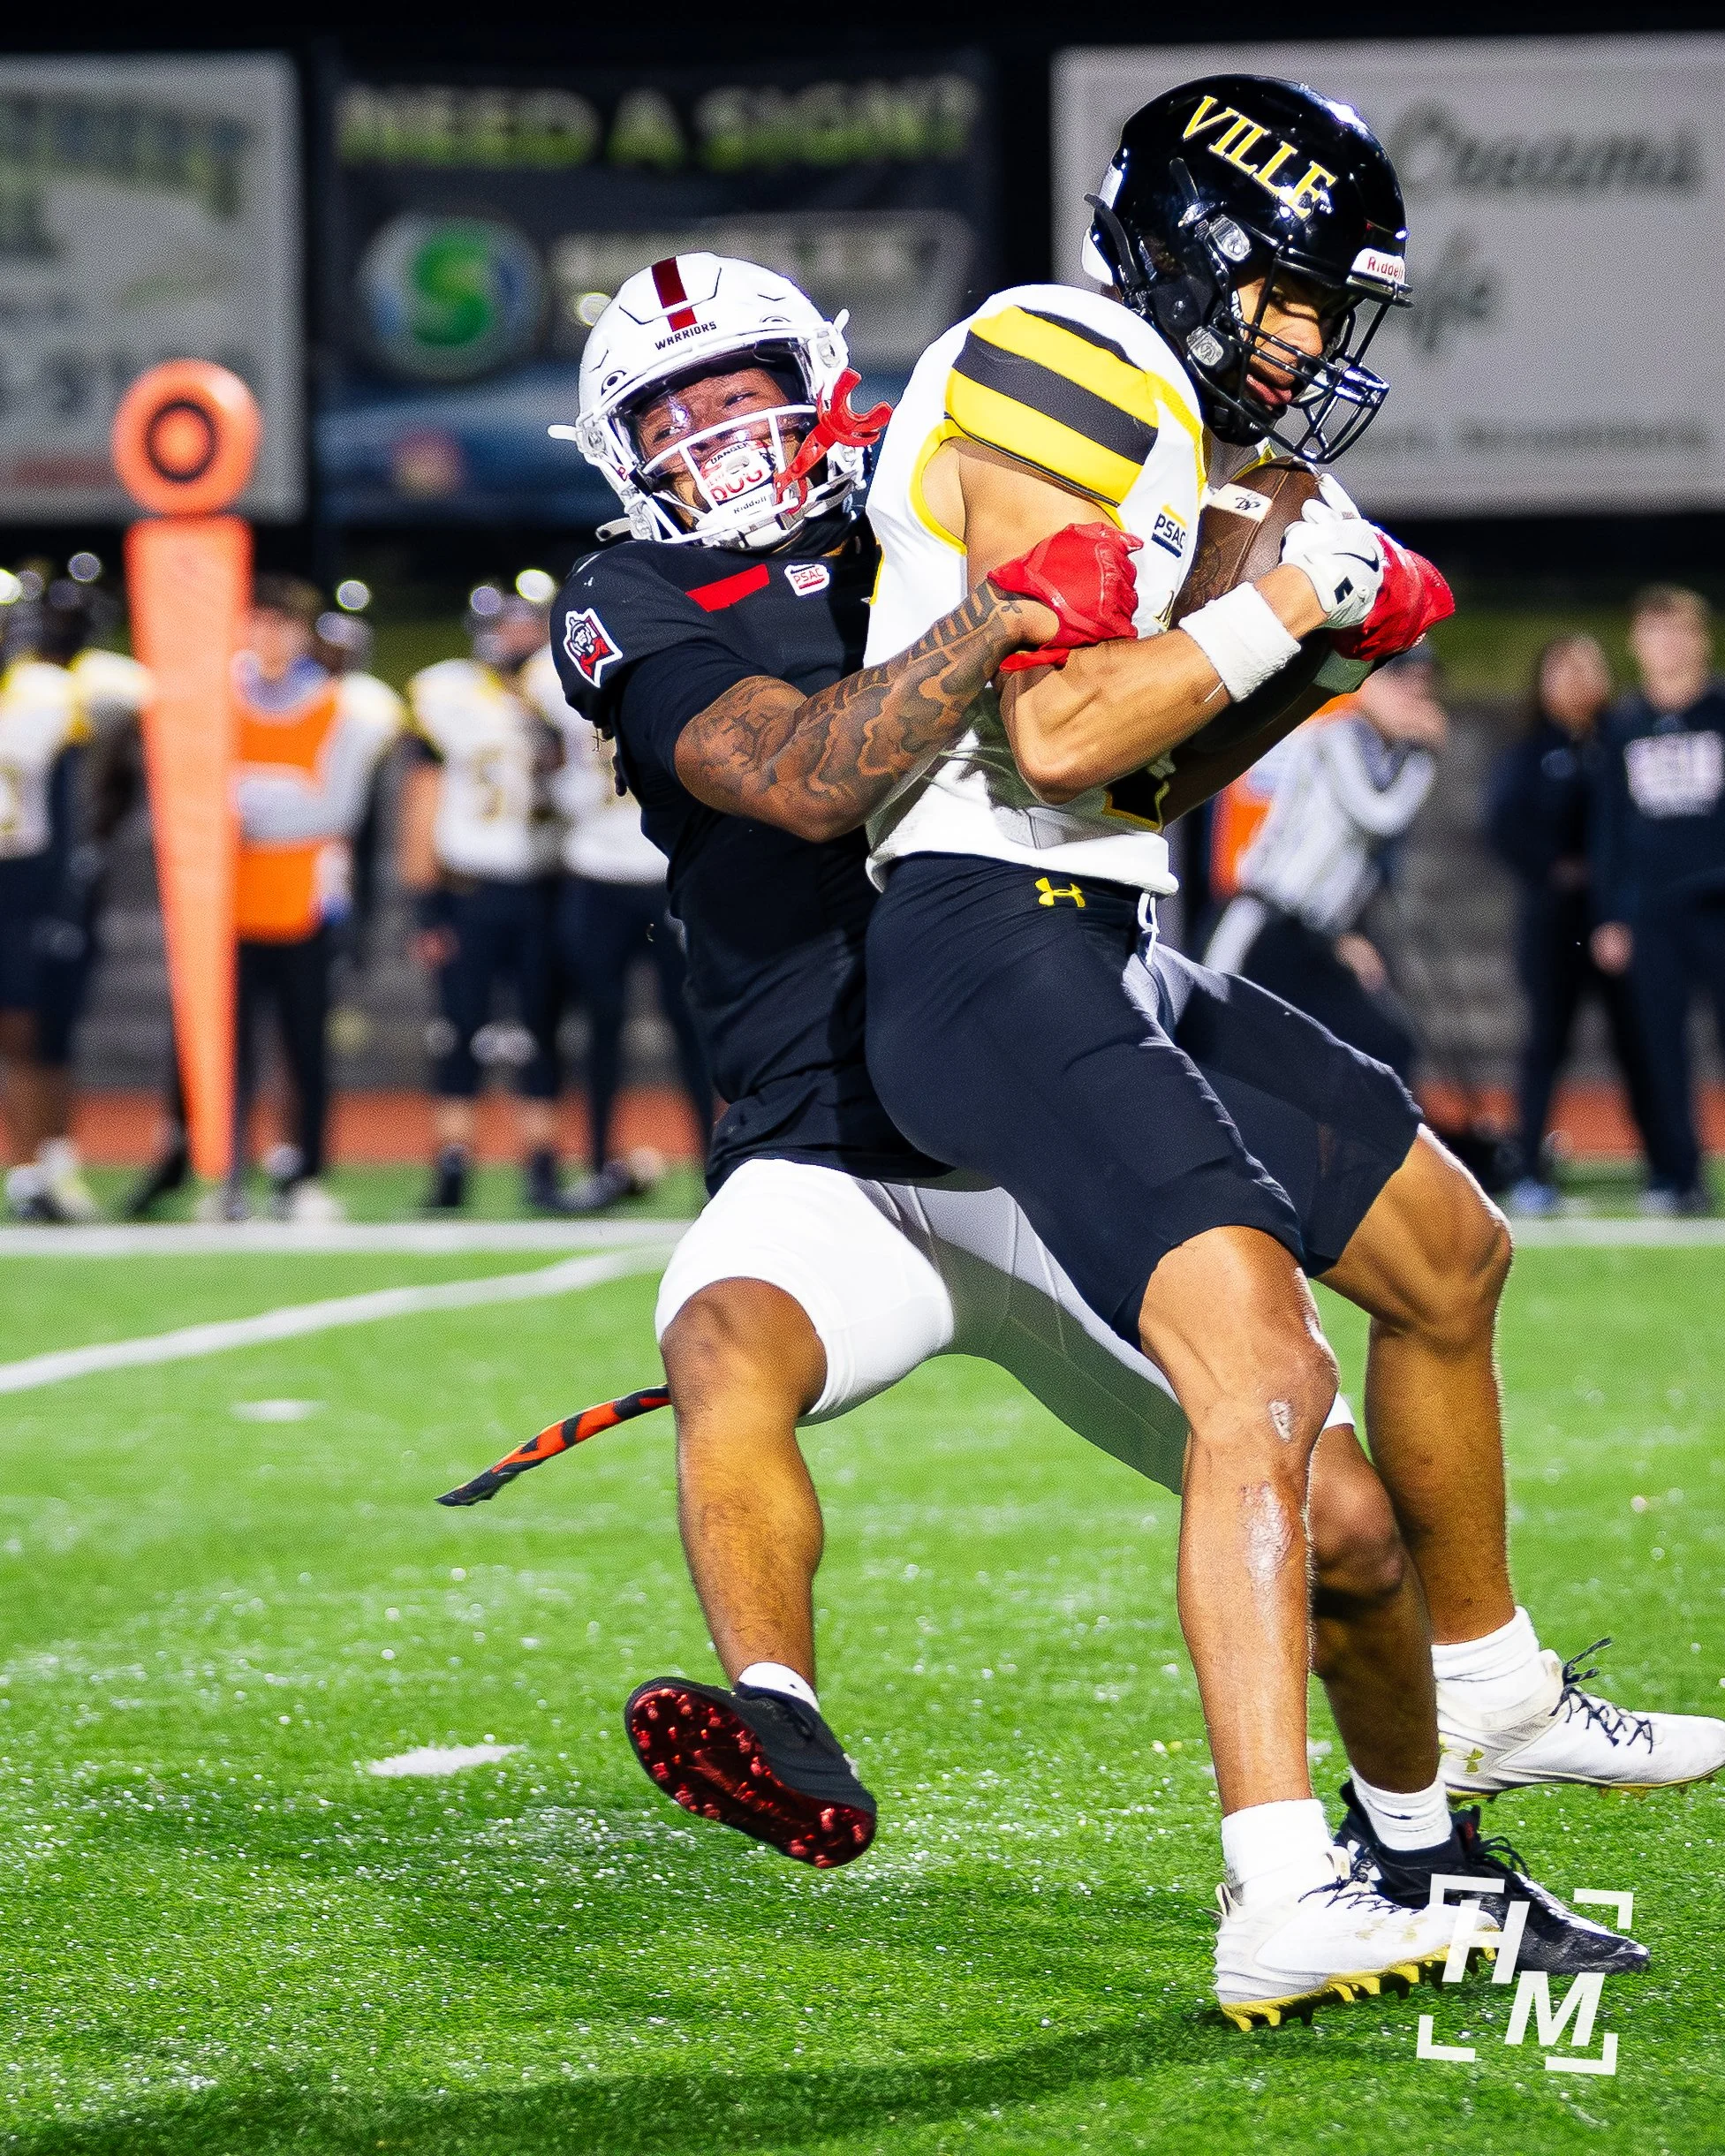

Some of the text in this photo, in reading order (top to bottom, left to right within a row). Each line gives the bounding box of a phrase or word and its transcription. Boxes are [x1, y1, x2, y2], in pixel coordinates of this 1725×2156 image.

[1183, 95, 1338, 219] VILLE
[1366, 256, 1403, 280] Riddell
[654, 321, 717, 351] WARRIORS
[733, 496, 768, 514] Riddell
[1154, 512, 1186, 549] PSAC
[793, 568, 824, 584] PSAC
